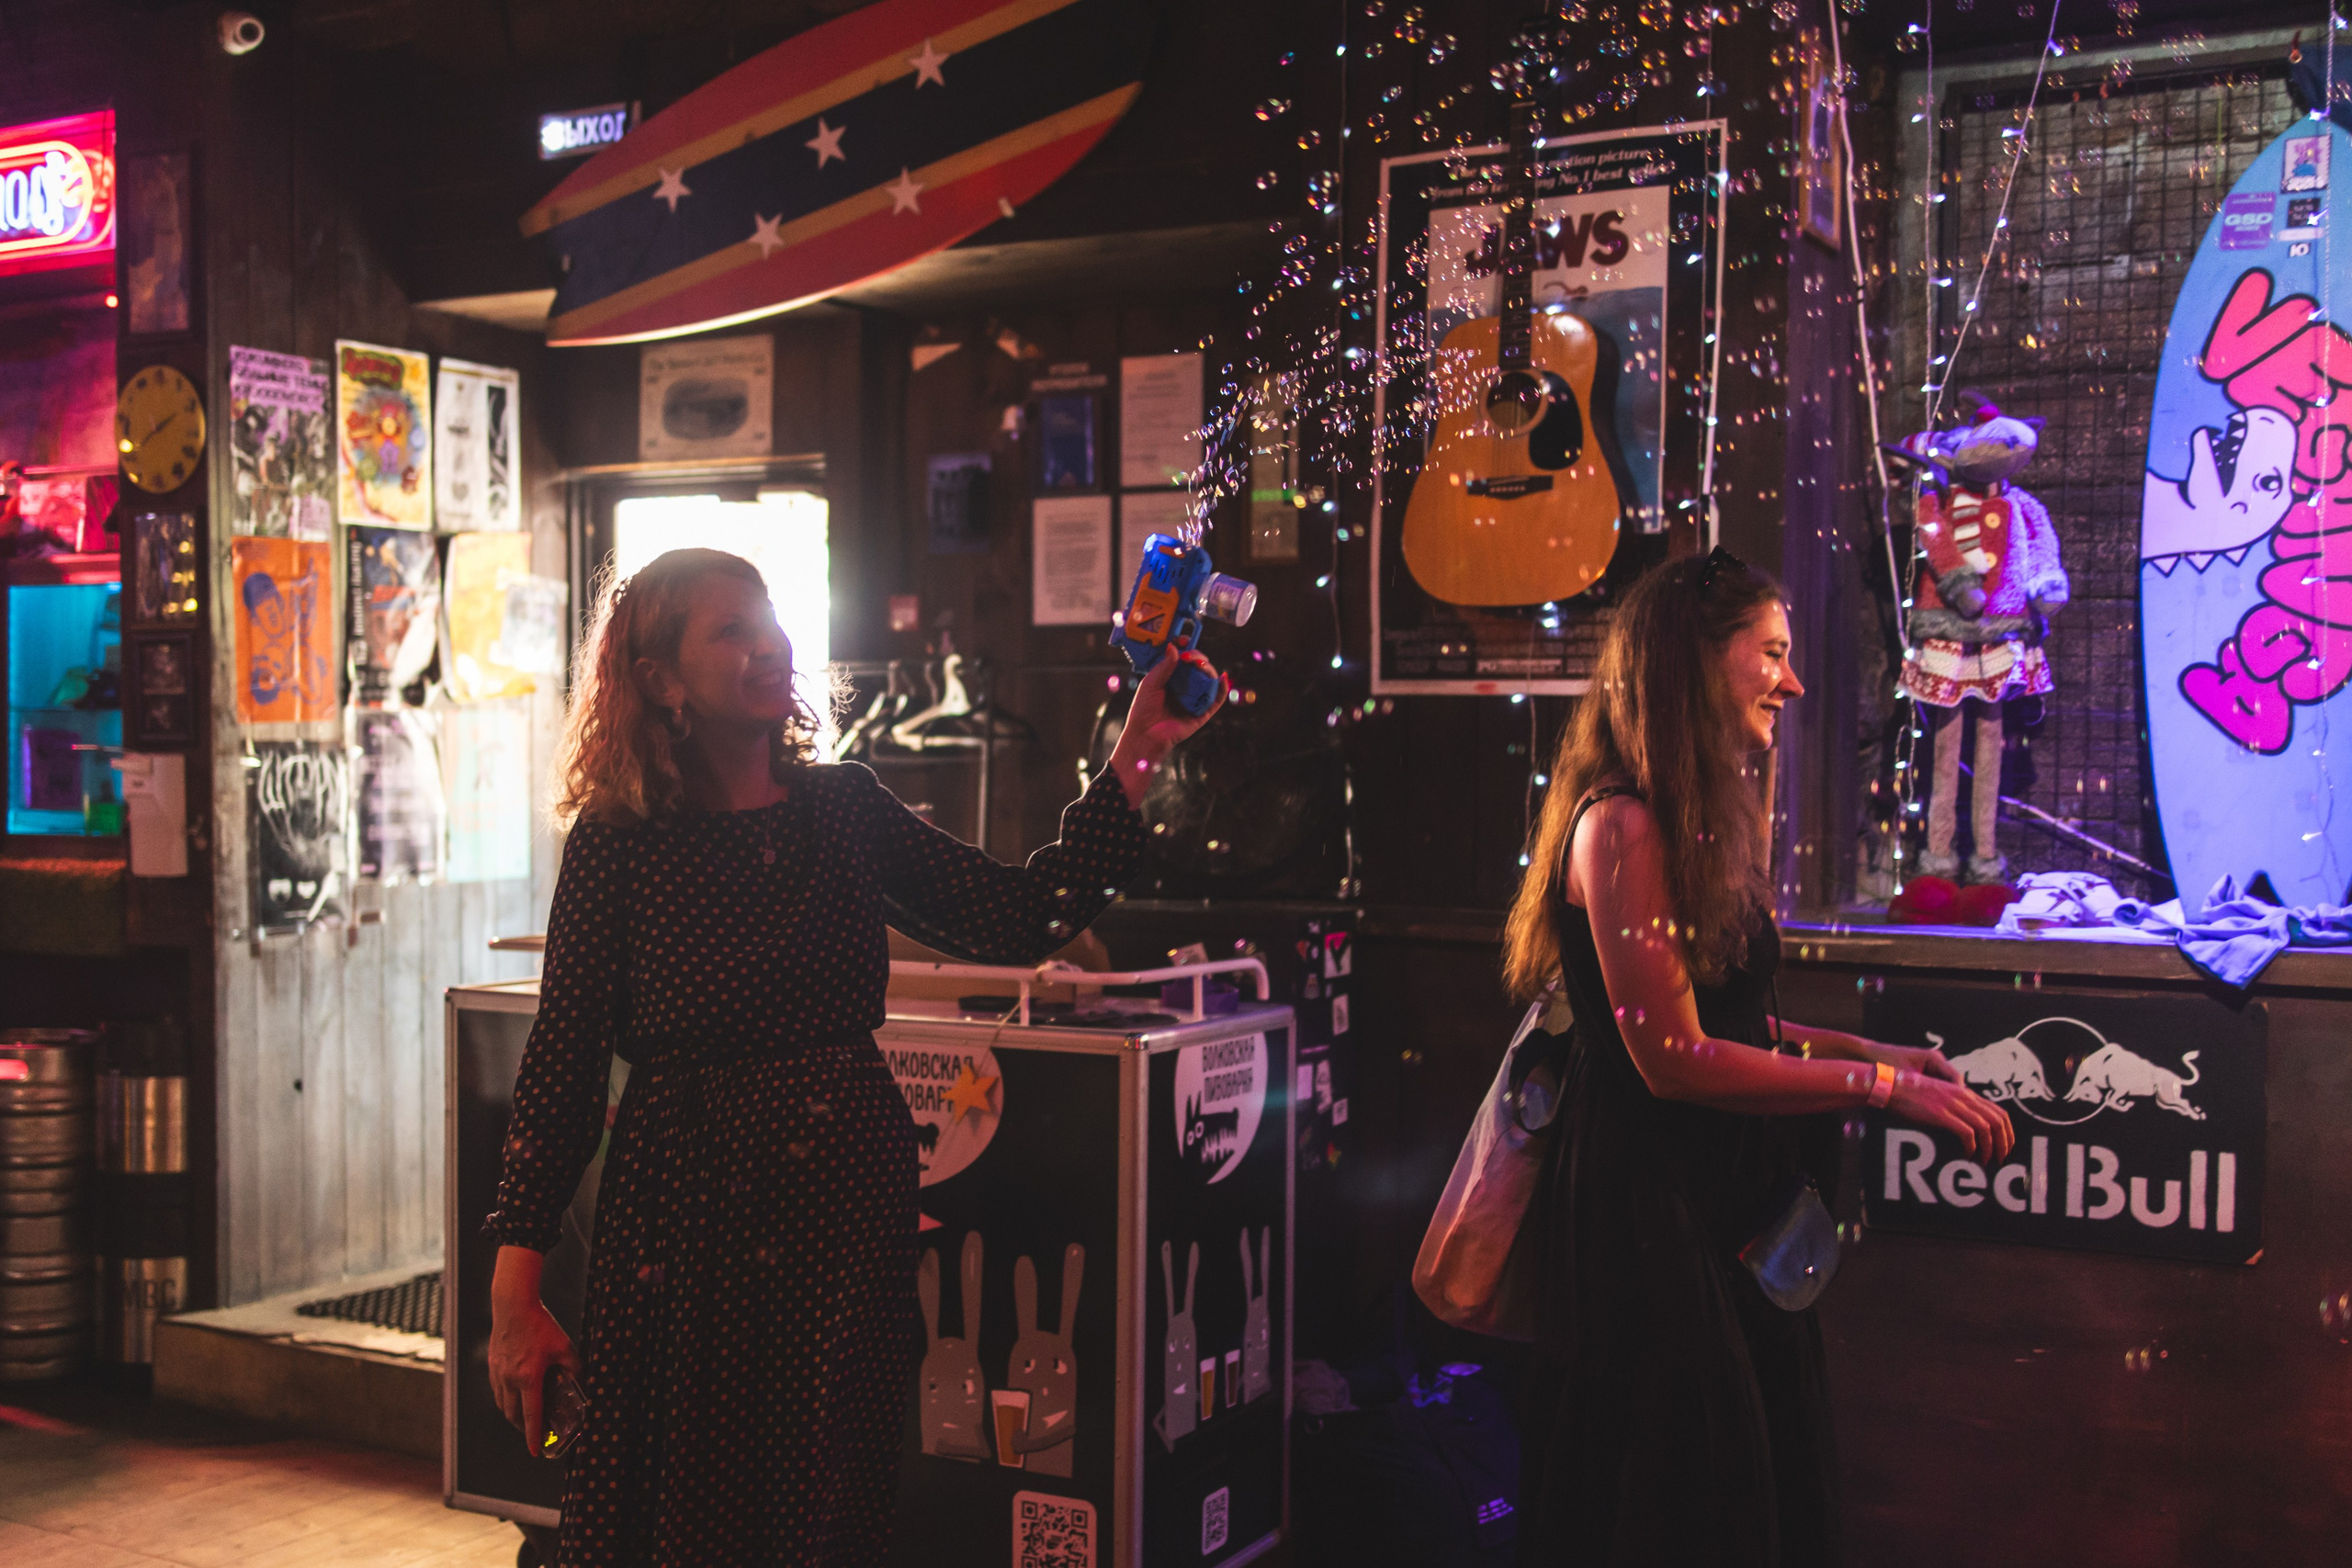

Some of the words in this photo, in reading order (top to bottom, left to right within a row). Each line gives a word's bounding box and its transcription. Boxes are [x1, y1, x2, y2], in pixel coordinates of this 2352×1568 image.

[1591, 166, 1624, 182] best
[1598, 147, 1650, 166] picture
[1464, 210, 1630, 275] JWS
[1203, 1036, 1255, 1072] ВОЛКОВСКАЯ
[1204, 1066, 1253, 1103] ПИВОВАРНЯ
[1884, 1128, 2048, 1214] Red
[2065, 1142, 2236, 1233] Bull
